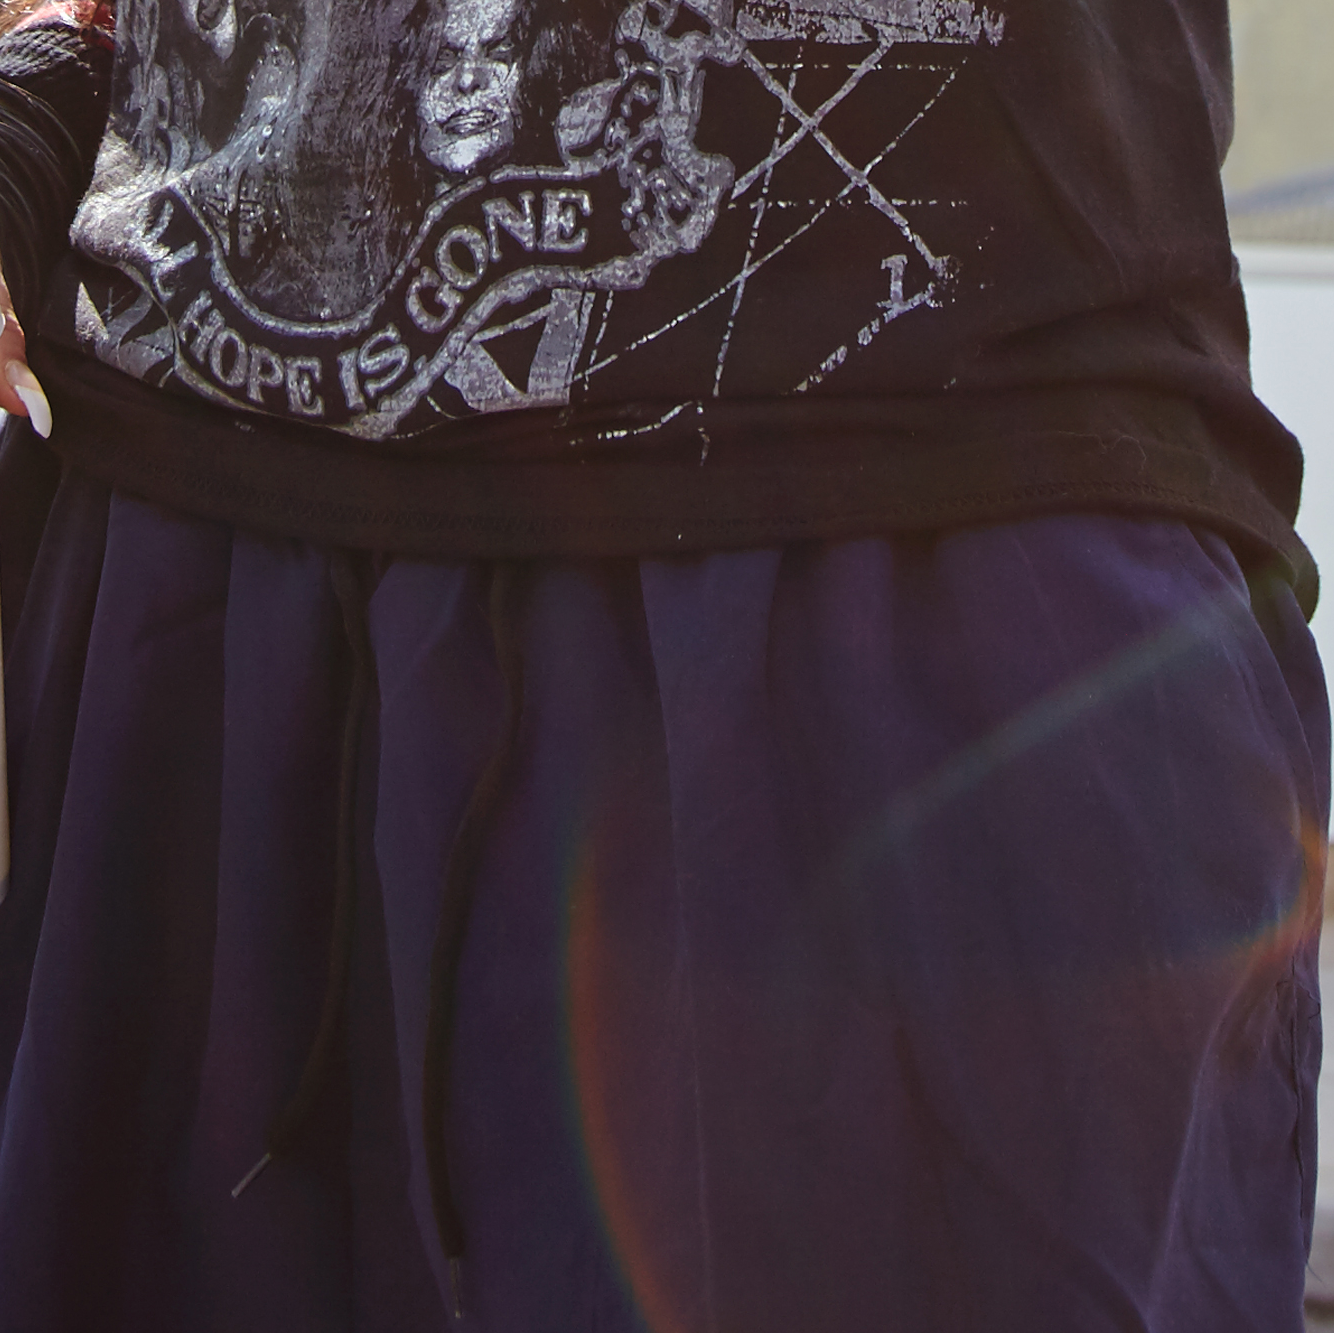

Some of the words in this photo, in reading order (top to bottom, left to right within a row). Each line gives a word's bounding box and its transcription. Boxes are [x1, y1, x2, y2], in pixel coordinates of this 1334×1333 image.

[177, 289, 326, 417] HOPE
[336, 322, 411, 411] IS
[405, 188, 594, 334] GONE
